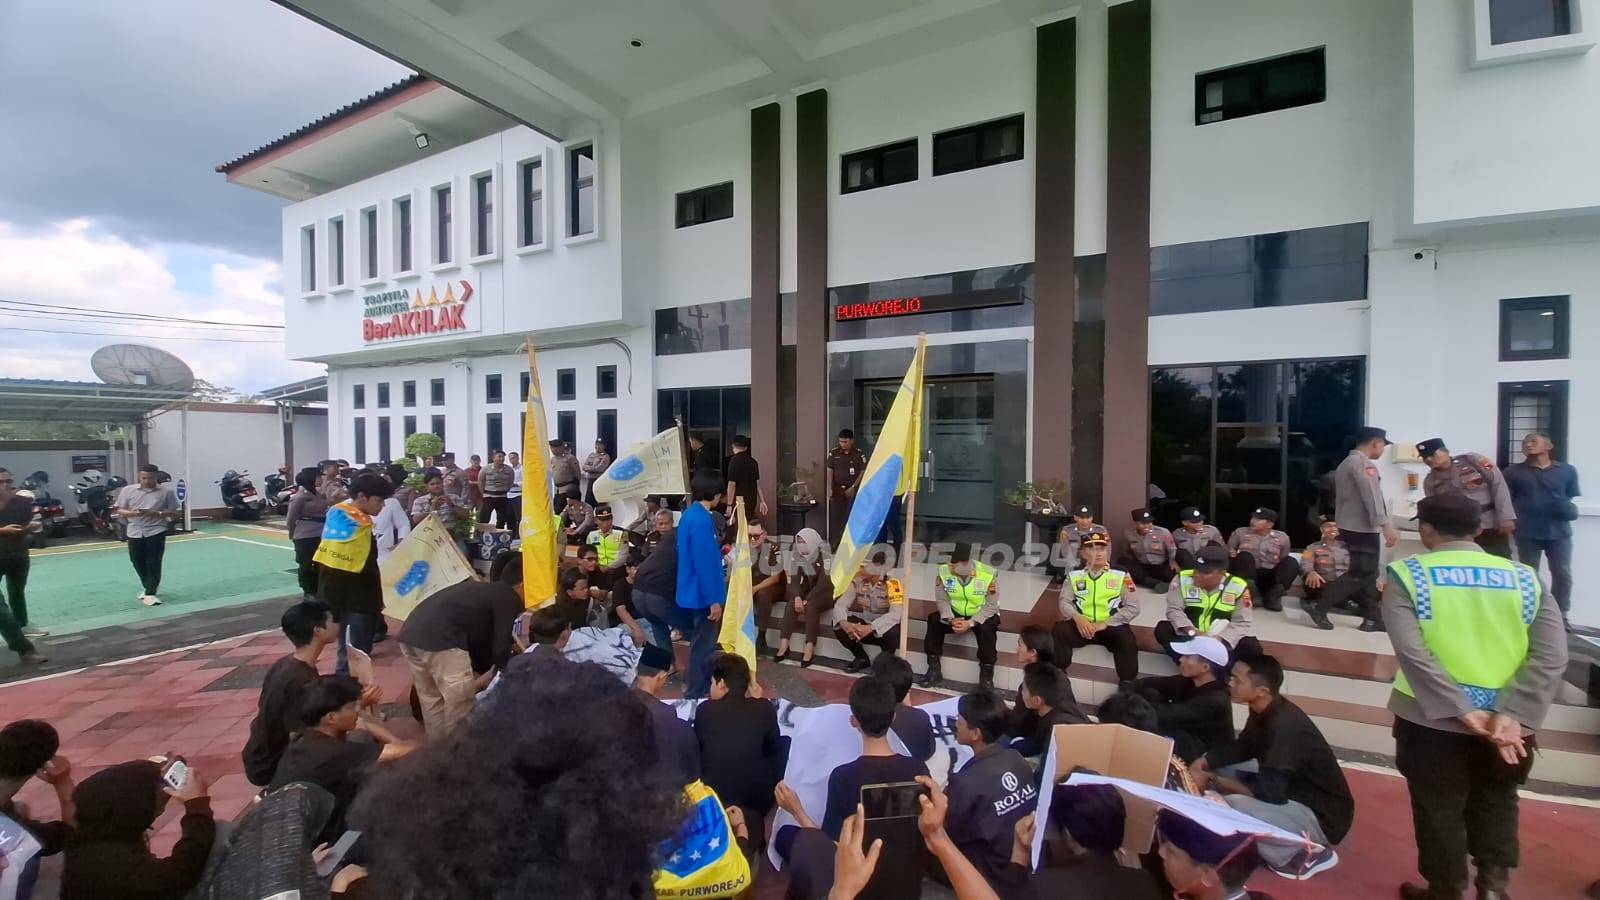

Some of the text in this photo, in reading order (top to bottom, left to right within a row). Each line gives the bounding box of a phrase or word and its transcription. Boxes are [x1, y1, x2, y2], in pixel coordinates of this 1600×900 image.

[836, 297, 921, 320] PURWOREJO
[362, 303, 466, 341] BerAKHLAK
[1432, 566, 1515, 588] POLISI
[993, 784, 1036, 811] ROYAL
[680, 874, 745, 897] PURWOREJO
